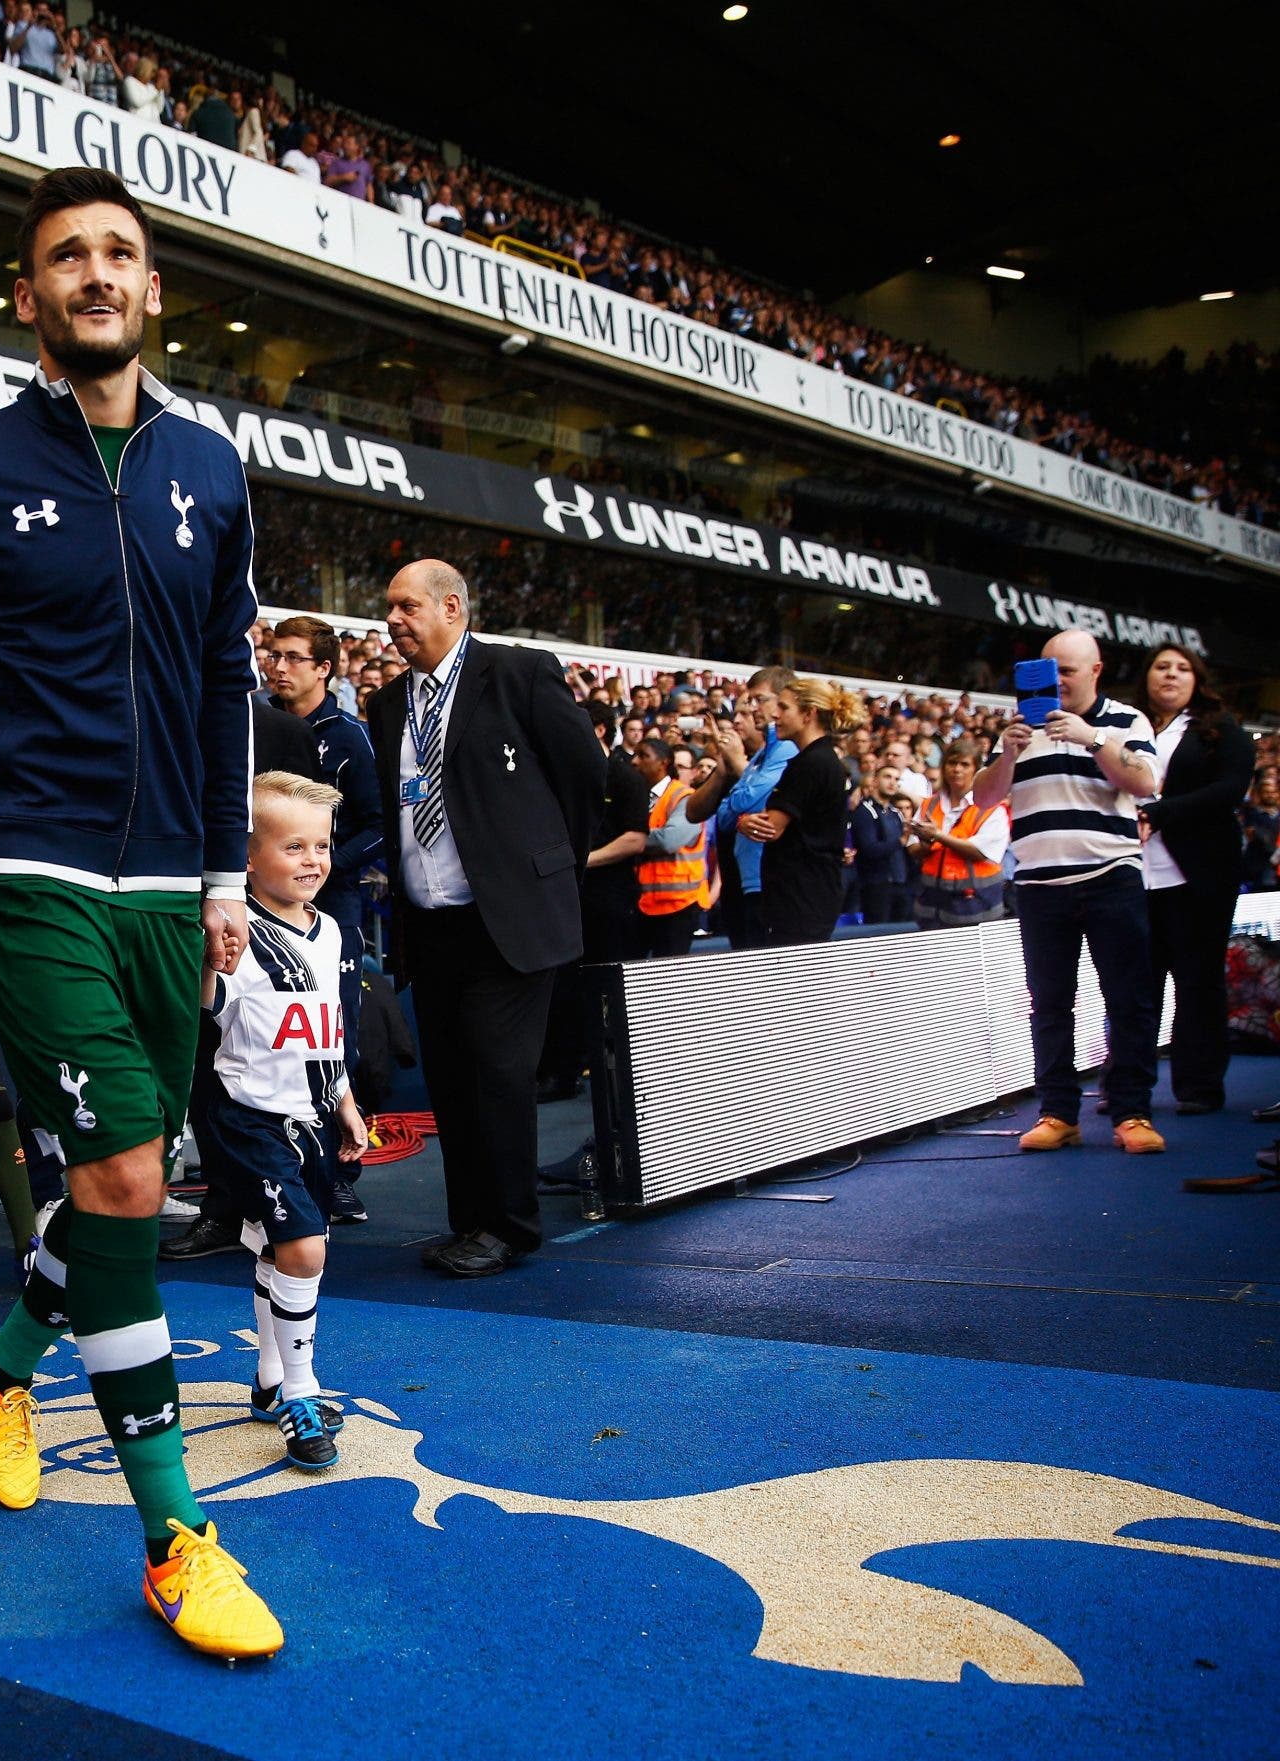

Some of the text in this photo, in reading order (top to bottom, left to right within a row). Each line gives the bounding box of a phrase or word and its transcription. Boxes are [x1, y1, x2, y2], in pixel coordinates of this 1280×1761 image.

[74, 110, 236, 217] GLORY
[398, 227, 761, 392] TOTTENHAM HOTSPUR
[844, 385, 1016, 476] TO DARE IS TO DO
[605, 497, 937, 606] UNDER ARMOUR
[1023, 592, 1114, 640] UNDER
[272, 1002, 345, 1050] AIA
